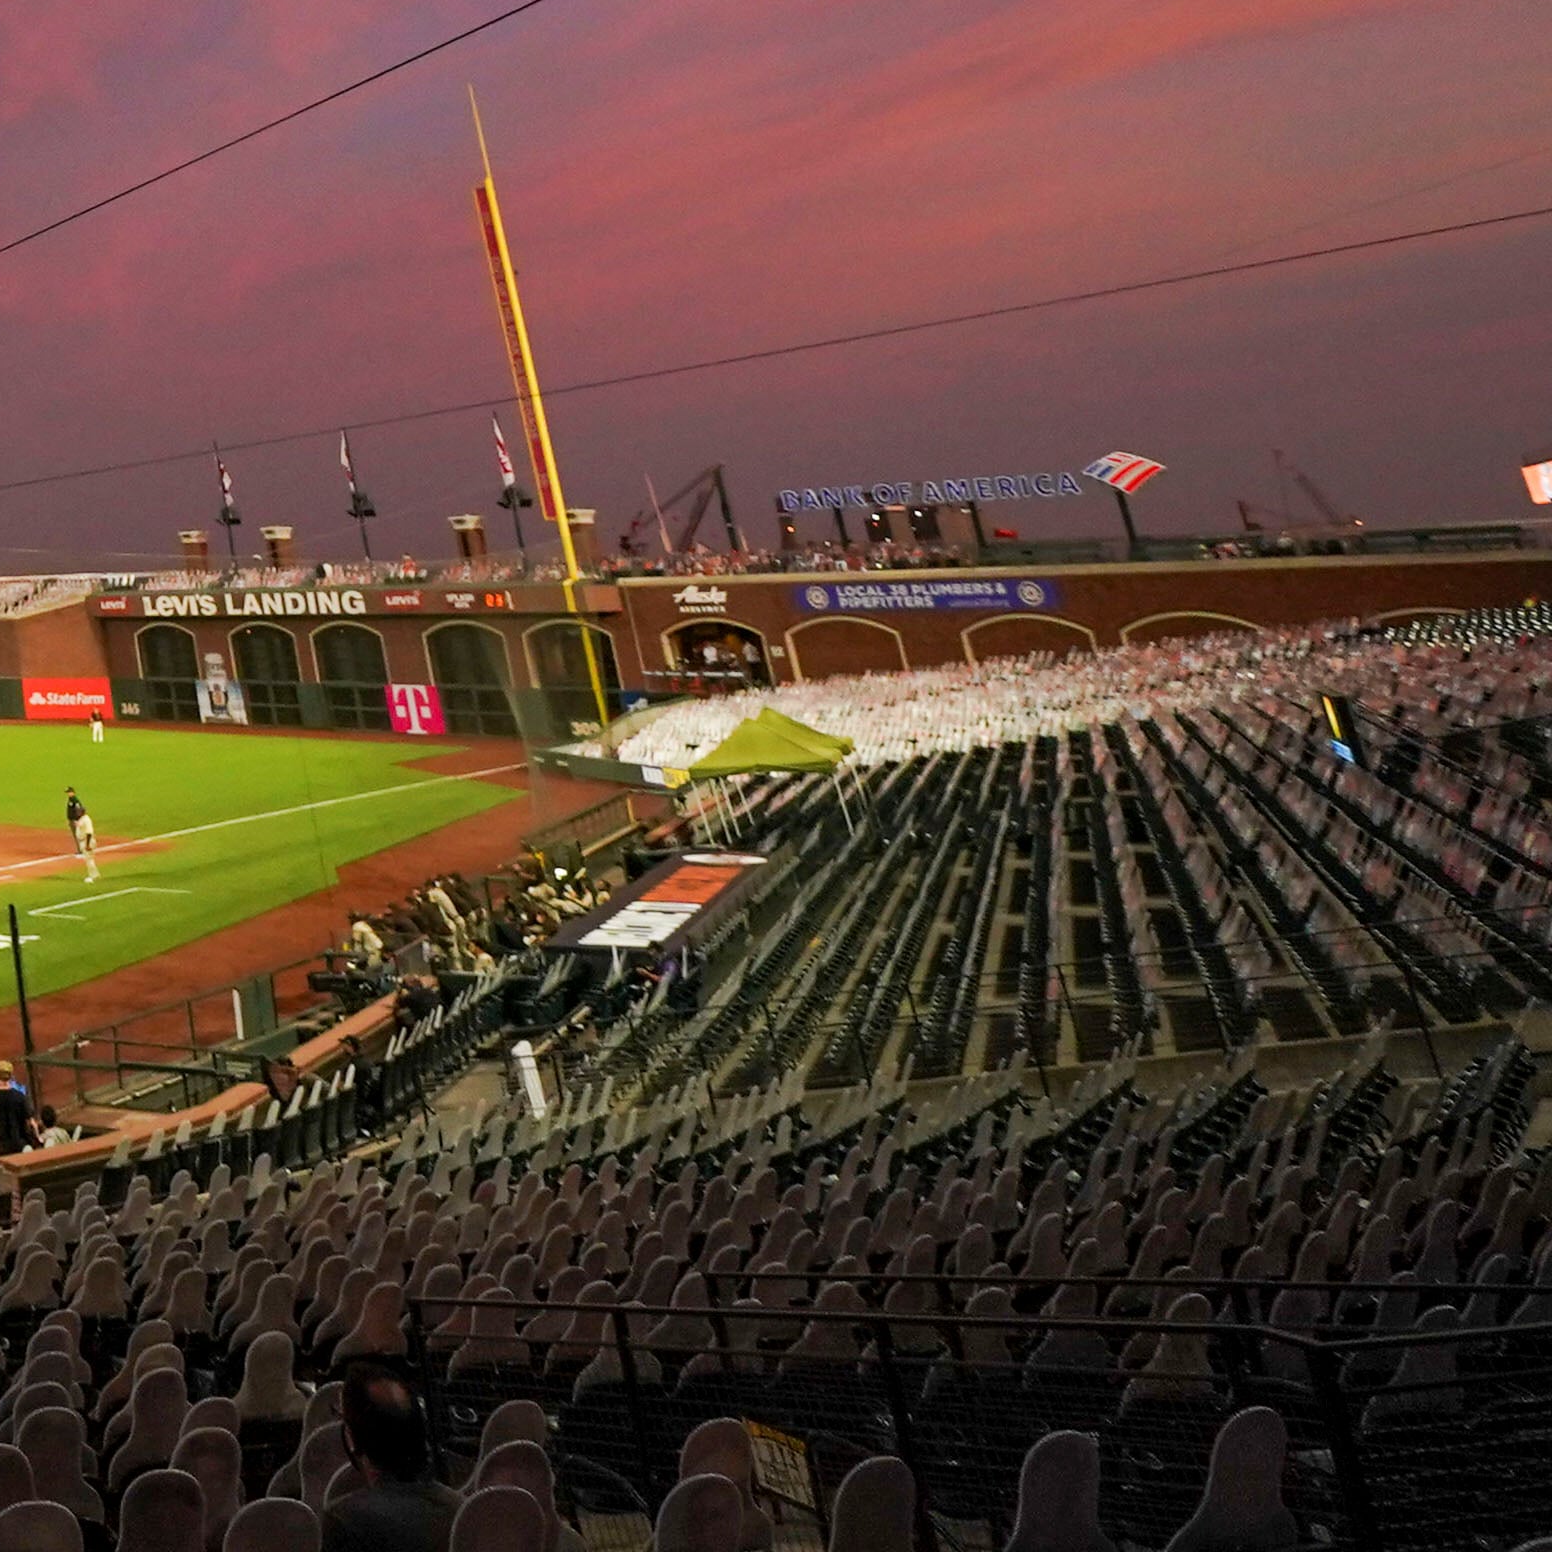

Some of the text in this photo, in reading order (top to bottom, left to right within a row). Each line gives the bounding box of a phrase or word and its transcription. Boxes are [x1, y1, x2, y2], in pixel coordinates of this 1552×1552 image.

[780, 472, 1082, 512] BANK OF AMERICA
[836, 584, 887, 598] LOCAL
[911, 582, 993, 596] PLUMBERS
[224, 590, 366, 616] LANDING
[837, 596, 934, 609] PIPEFITTERS
